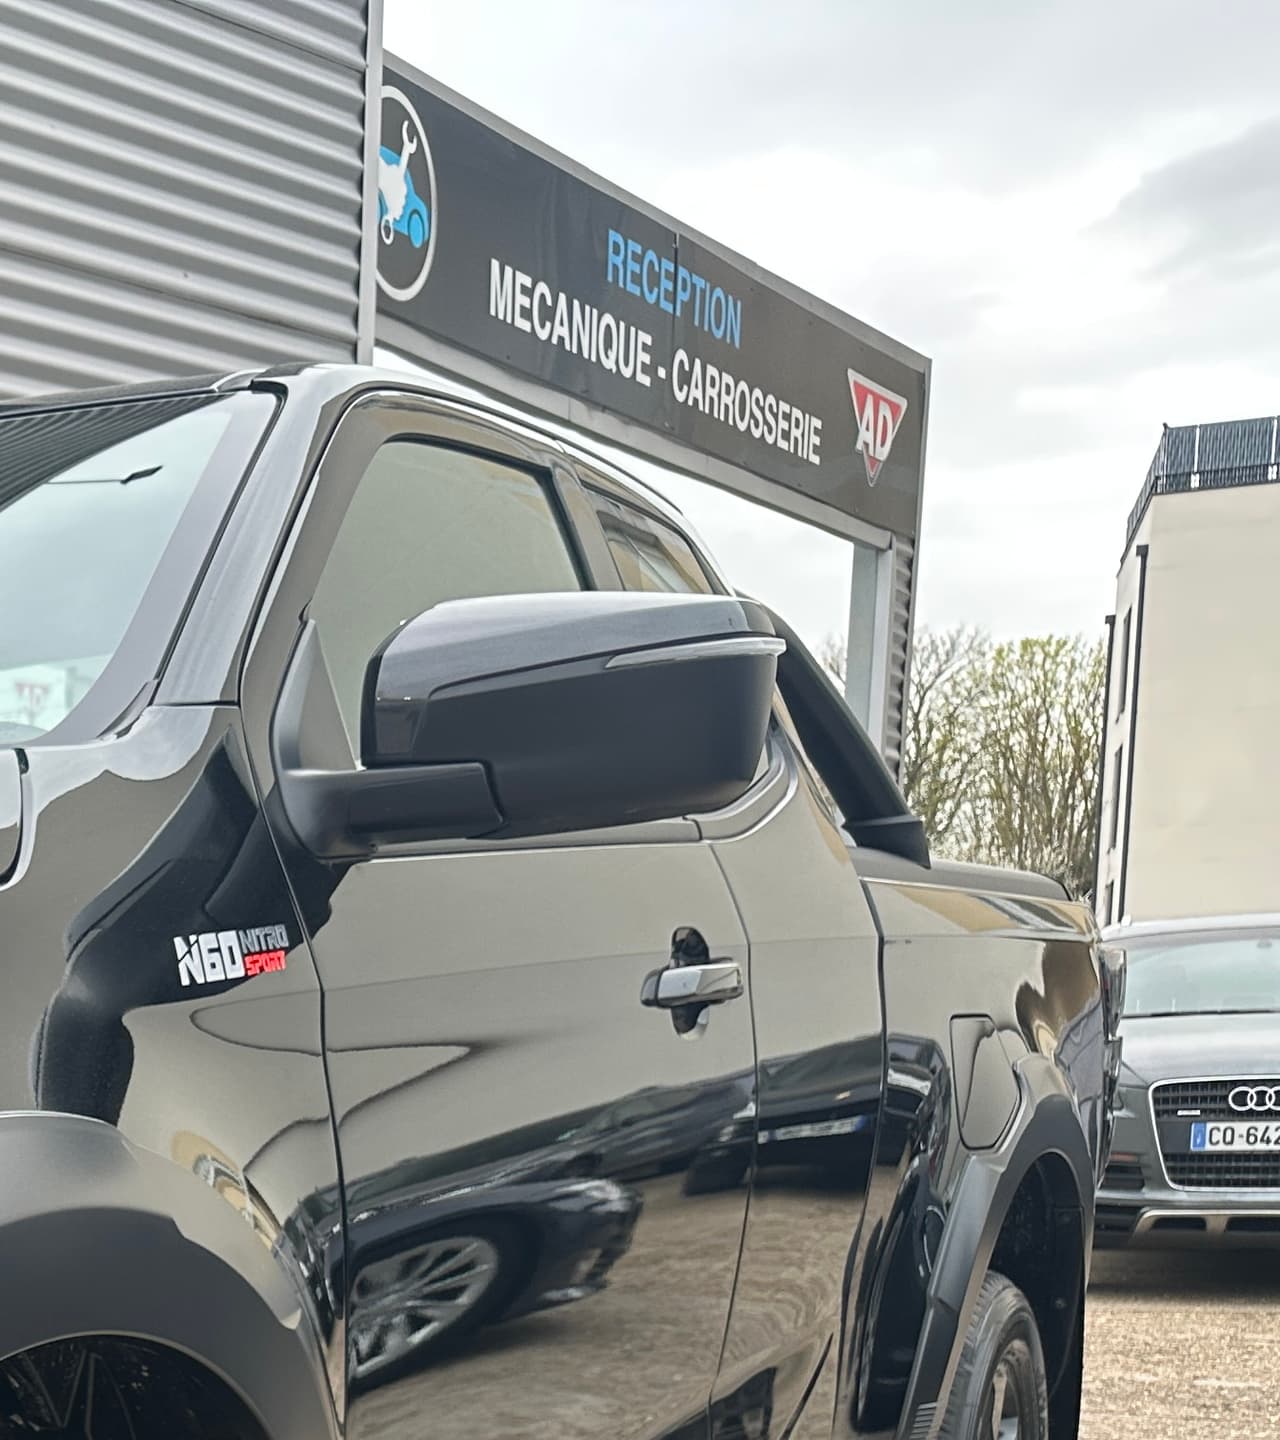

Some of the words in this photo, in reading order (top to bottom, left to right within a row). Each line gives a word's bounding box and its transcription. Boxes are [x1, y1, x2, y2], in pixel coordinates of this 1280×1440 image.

[607, 229, 741, 349] RECEPTION
[489, 258, 652, 388] MECANIQUE
[671, 346, 823, 467] CARROSSERIE
[855, 392, 894, 462] AD
[173, 929, 246, 987] N60
[244, 950, 288, 976] SPORT
